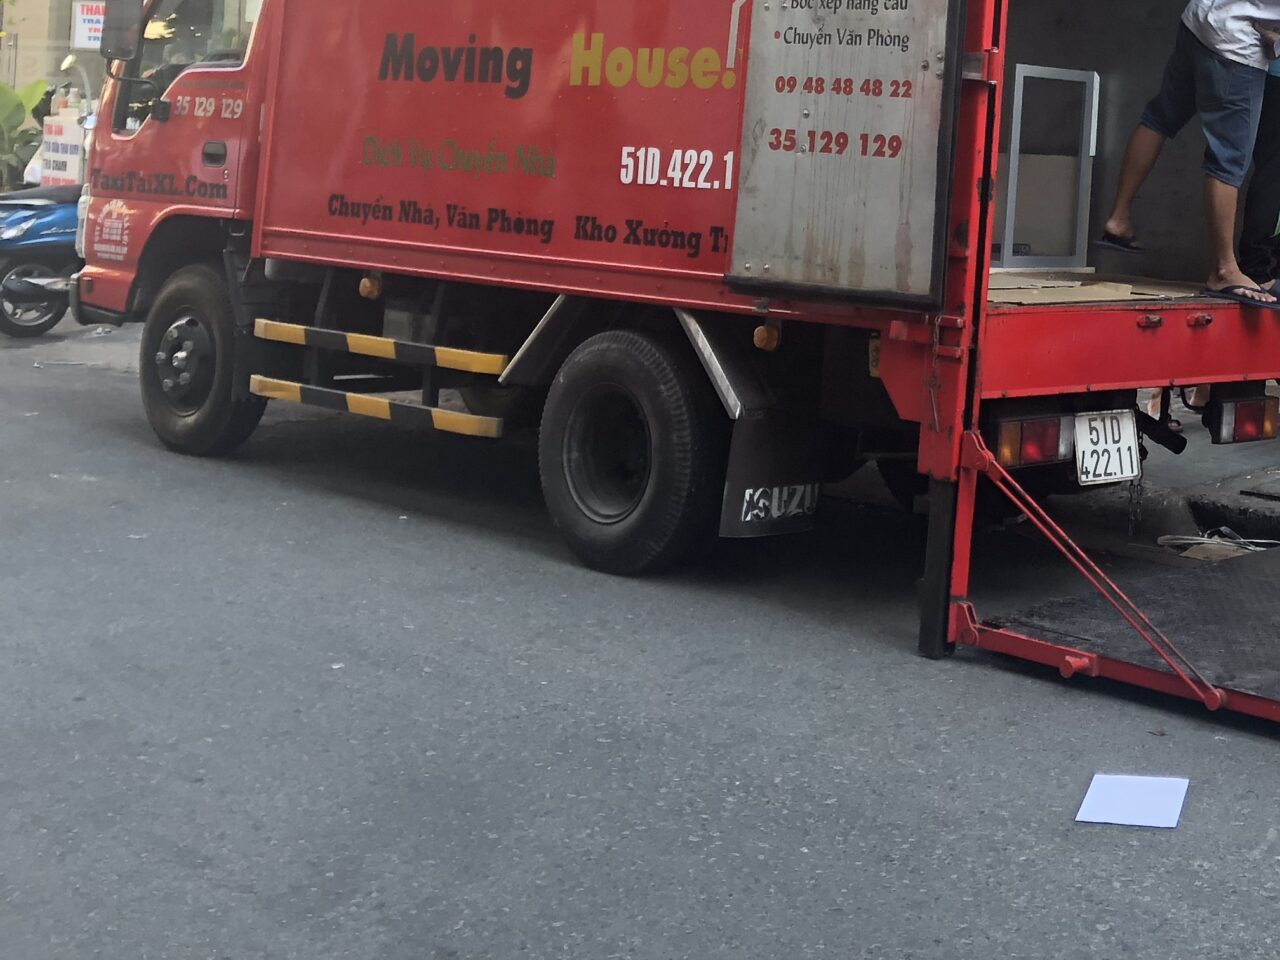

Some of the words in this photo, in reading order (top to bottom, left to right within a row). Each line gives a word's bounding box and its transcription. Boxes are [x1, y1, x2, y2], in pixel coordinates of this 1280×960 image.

[783, 24, 832, 50] Chuyển
[837, 27, 862, 46] Văn
[867, 28, 910, 52] Phòng
[378, 33, 533, 98] Moving
[775, 76, 798, 93] 09
[803, 77, 825, 94] 48
[831, 78, 853, 95] 48
[860, 79, 883, 96] 48
[889, 80, 913, 98] 22
[174, 95, 191, 116] 35
[193, 96, 216, 117] 129
[221, 98, 243, 119] 129
[859, 133, 902, 158] 129
[574, 215, 617, 243] Kho
[623, 219, 703, 258] Xưởng
[1087, 415, 1122, 446] 51D
[1080, 445, 1135, 479] 422.11
